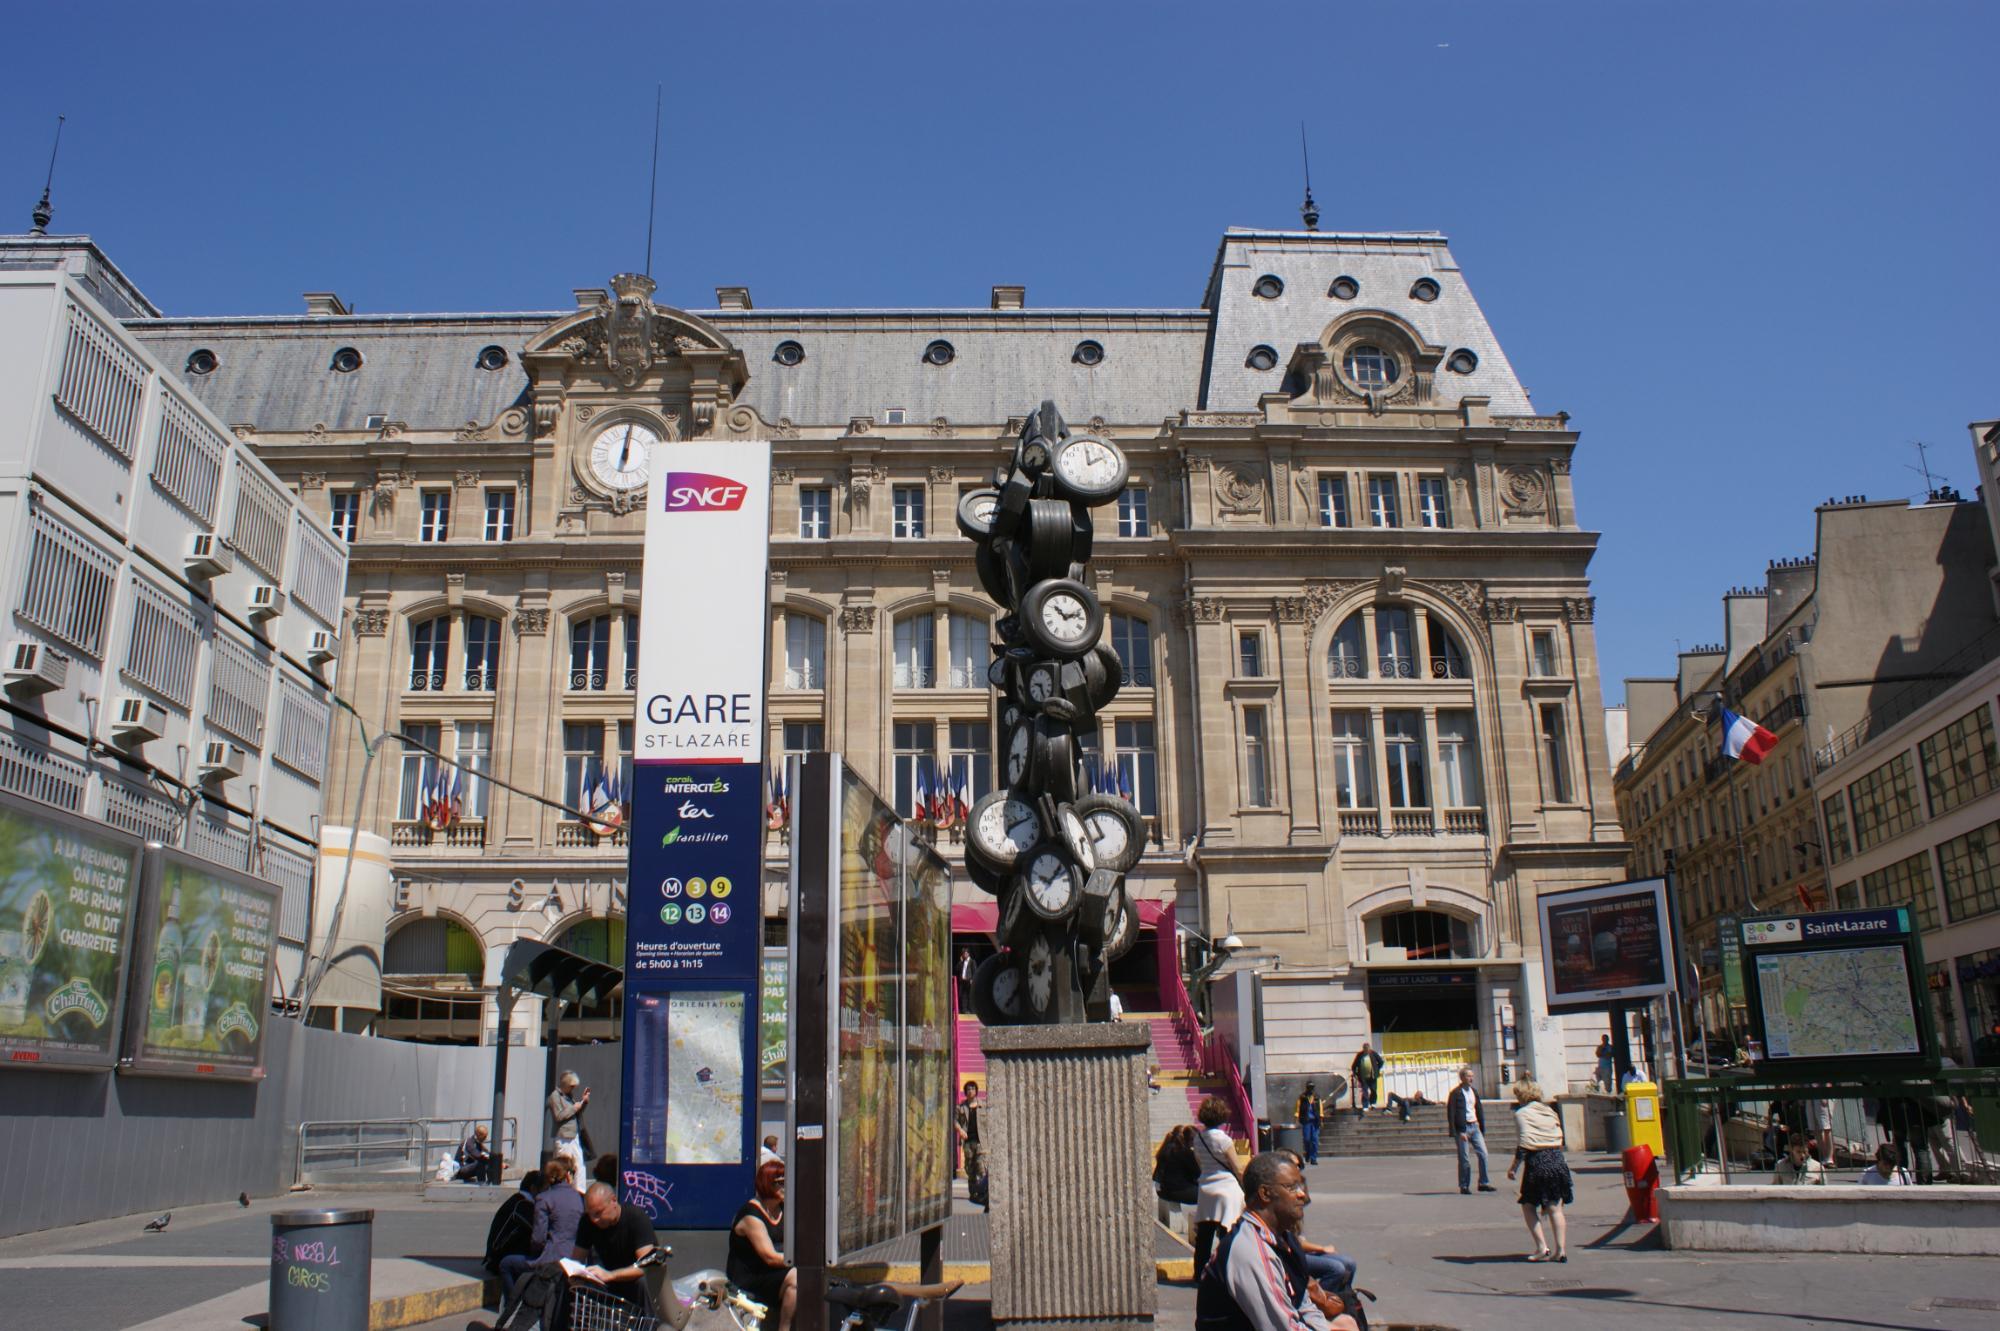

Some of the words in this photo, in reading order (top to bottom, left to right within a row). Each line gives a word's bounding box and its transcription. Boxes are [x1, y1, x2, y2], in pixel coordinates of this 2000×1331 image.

[669, 486, 743, 507] SNCF
[646, 694, 751, 725] GARE
[645, 733, 751, 748] ST-LAZARE
[678, 800, 715, 818] ter
[668, 831, 729, 843] Transilien
[73, 866, 89, 884] ON
[91, 871, 106, 889] NE
[108, 876, 125, 893] DIT
[692, 881, 700, 894] 3
[717, 881, 725, 894] 9
[70, 886, 89, 905] PAS
[90, 891, 122, 913] RHUM
[663, 907, 678, 920] 12
[688, 908, 703, 920] 13
[712, 907, 728, 920] 14
[84, 912, 101, 928] ON
[103, 916, 120, 933] DIT
[1807, 919, 1888, 935] Saint-Lazare
[60, 928, 118, 954] CHARRETTE
[636, 942, 667, 951] Heures
[669, 942, 721, 951] d'ouverture
[635, 959, 647, 969] de
[649, 960, 672, 969] 5h00
[672, 959, 679, 969] à
[681, 959, 703, 969] 1h15
[764, 975, 783, 985] ON
[763, 987, 785, 997] PAS
[671, 1000, 744, 1008] ORIENTATION
